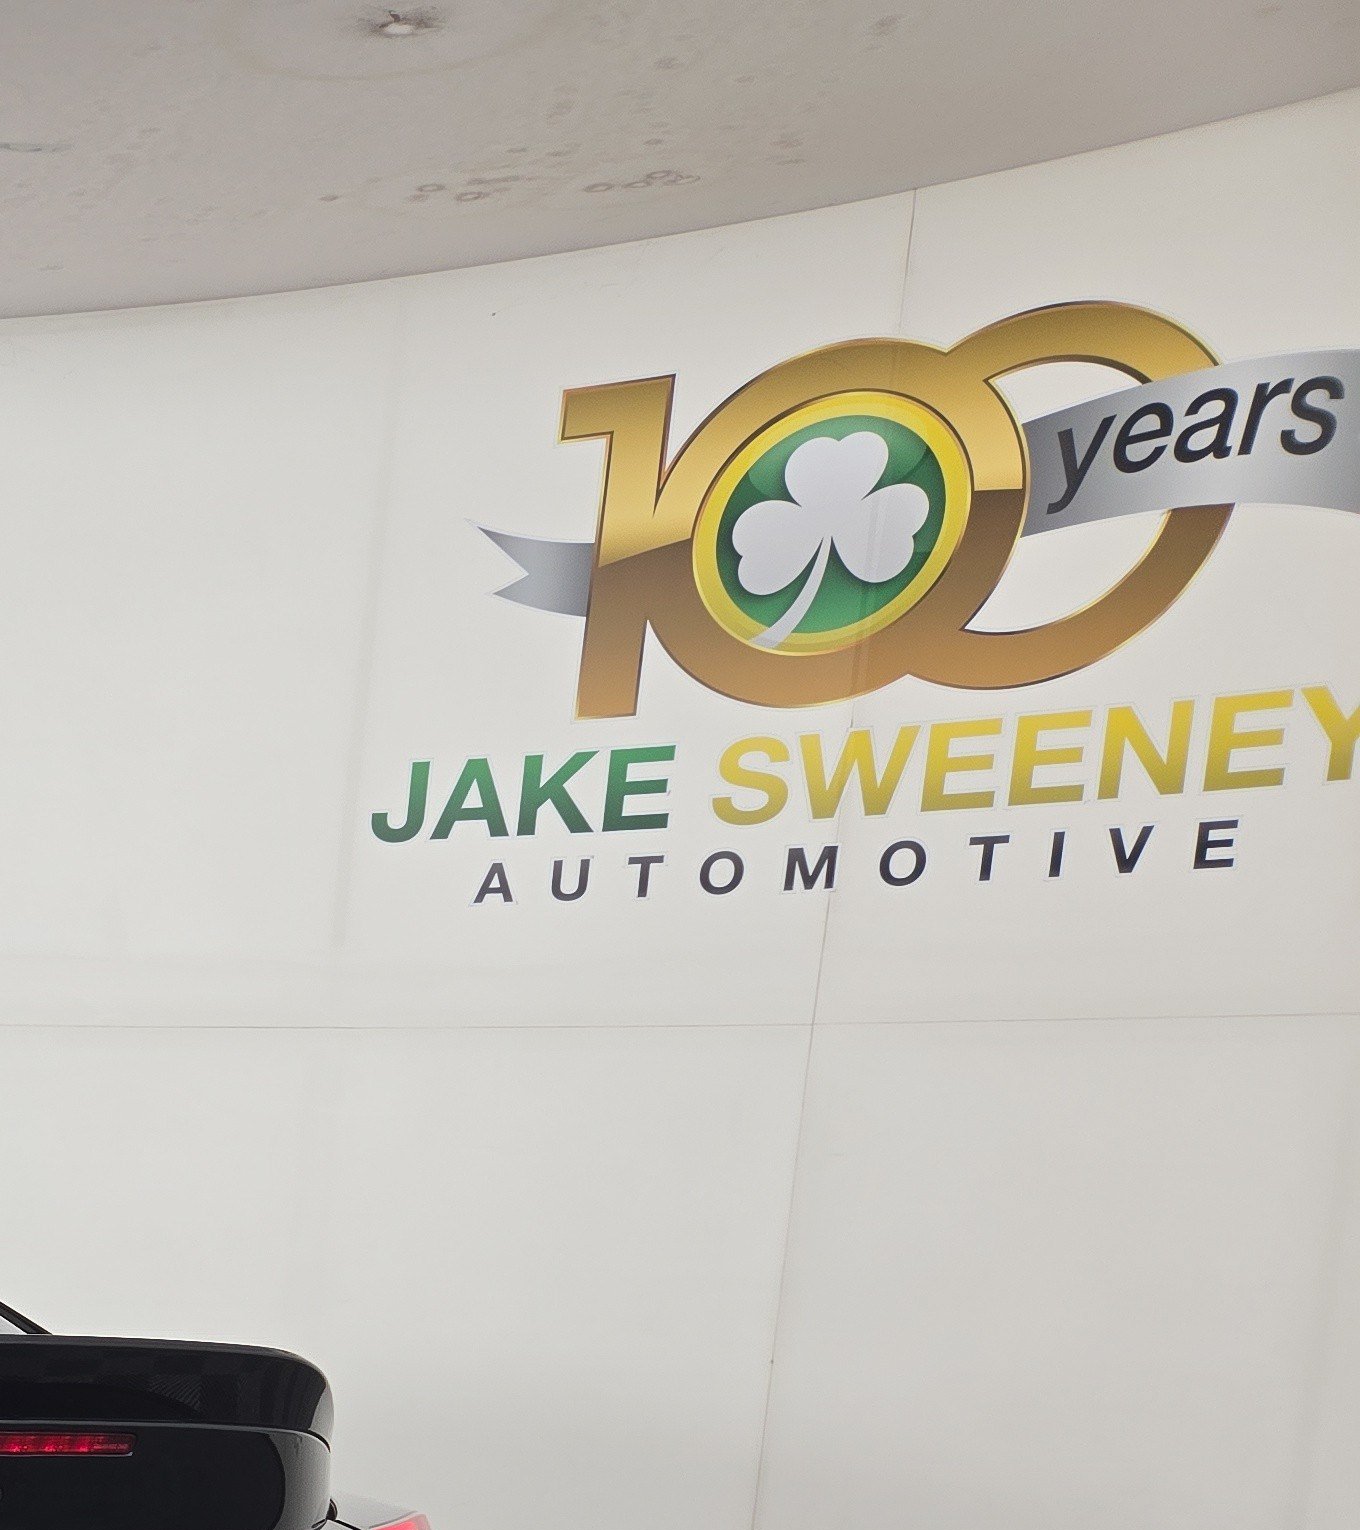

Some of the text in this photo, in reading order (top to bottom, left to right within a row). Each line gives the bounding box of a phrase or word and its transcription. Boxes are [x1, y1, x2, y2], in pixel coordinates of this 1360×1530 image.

[559, 300, 1236, 720] 100
[1047, 374, 1346, 514] years
[370, 684, 1360, 844] JAKE SWEENEY
[473, 818, 1240, 905] AUTOMOTIVE
